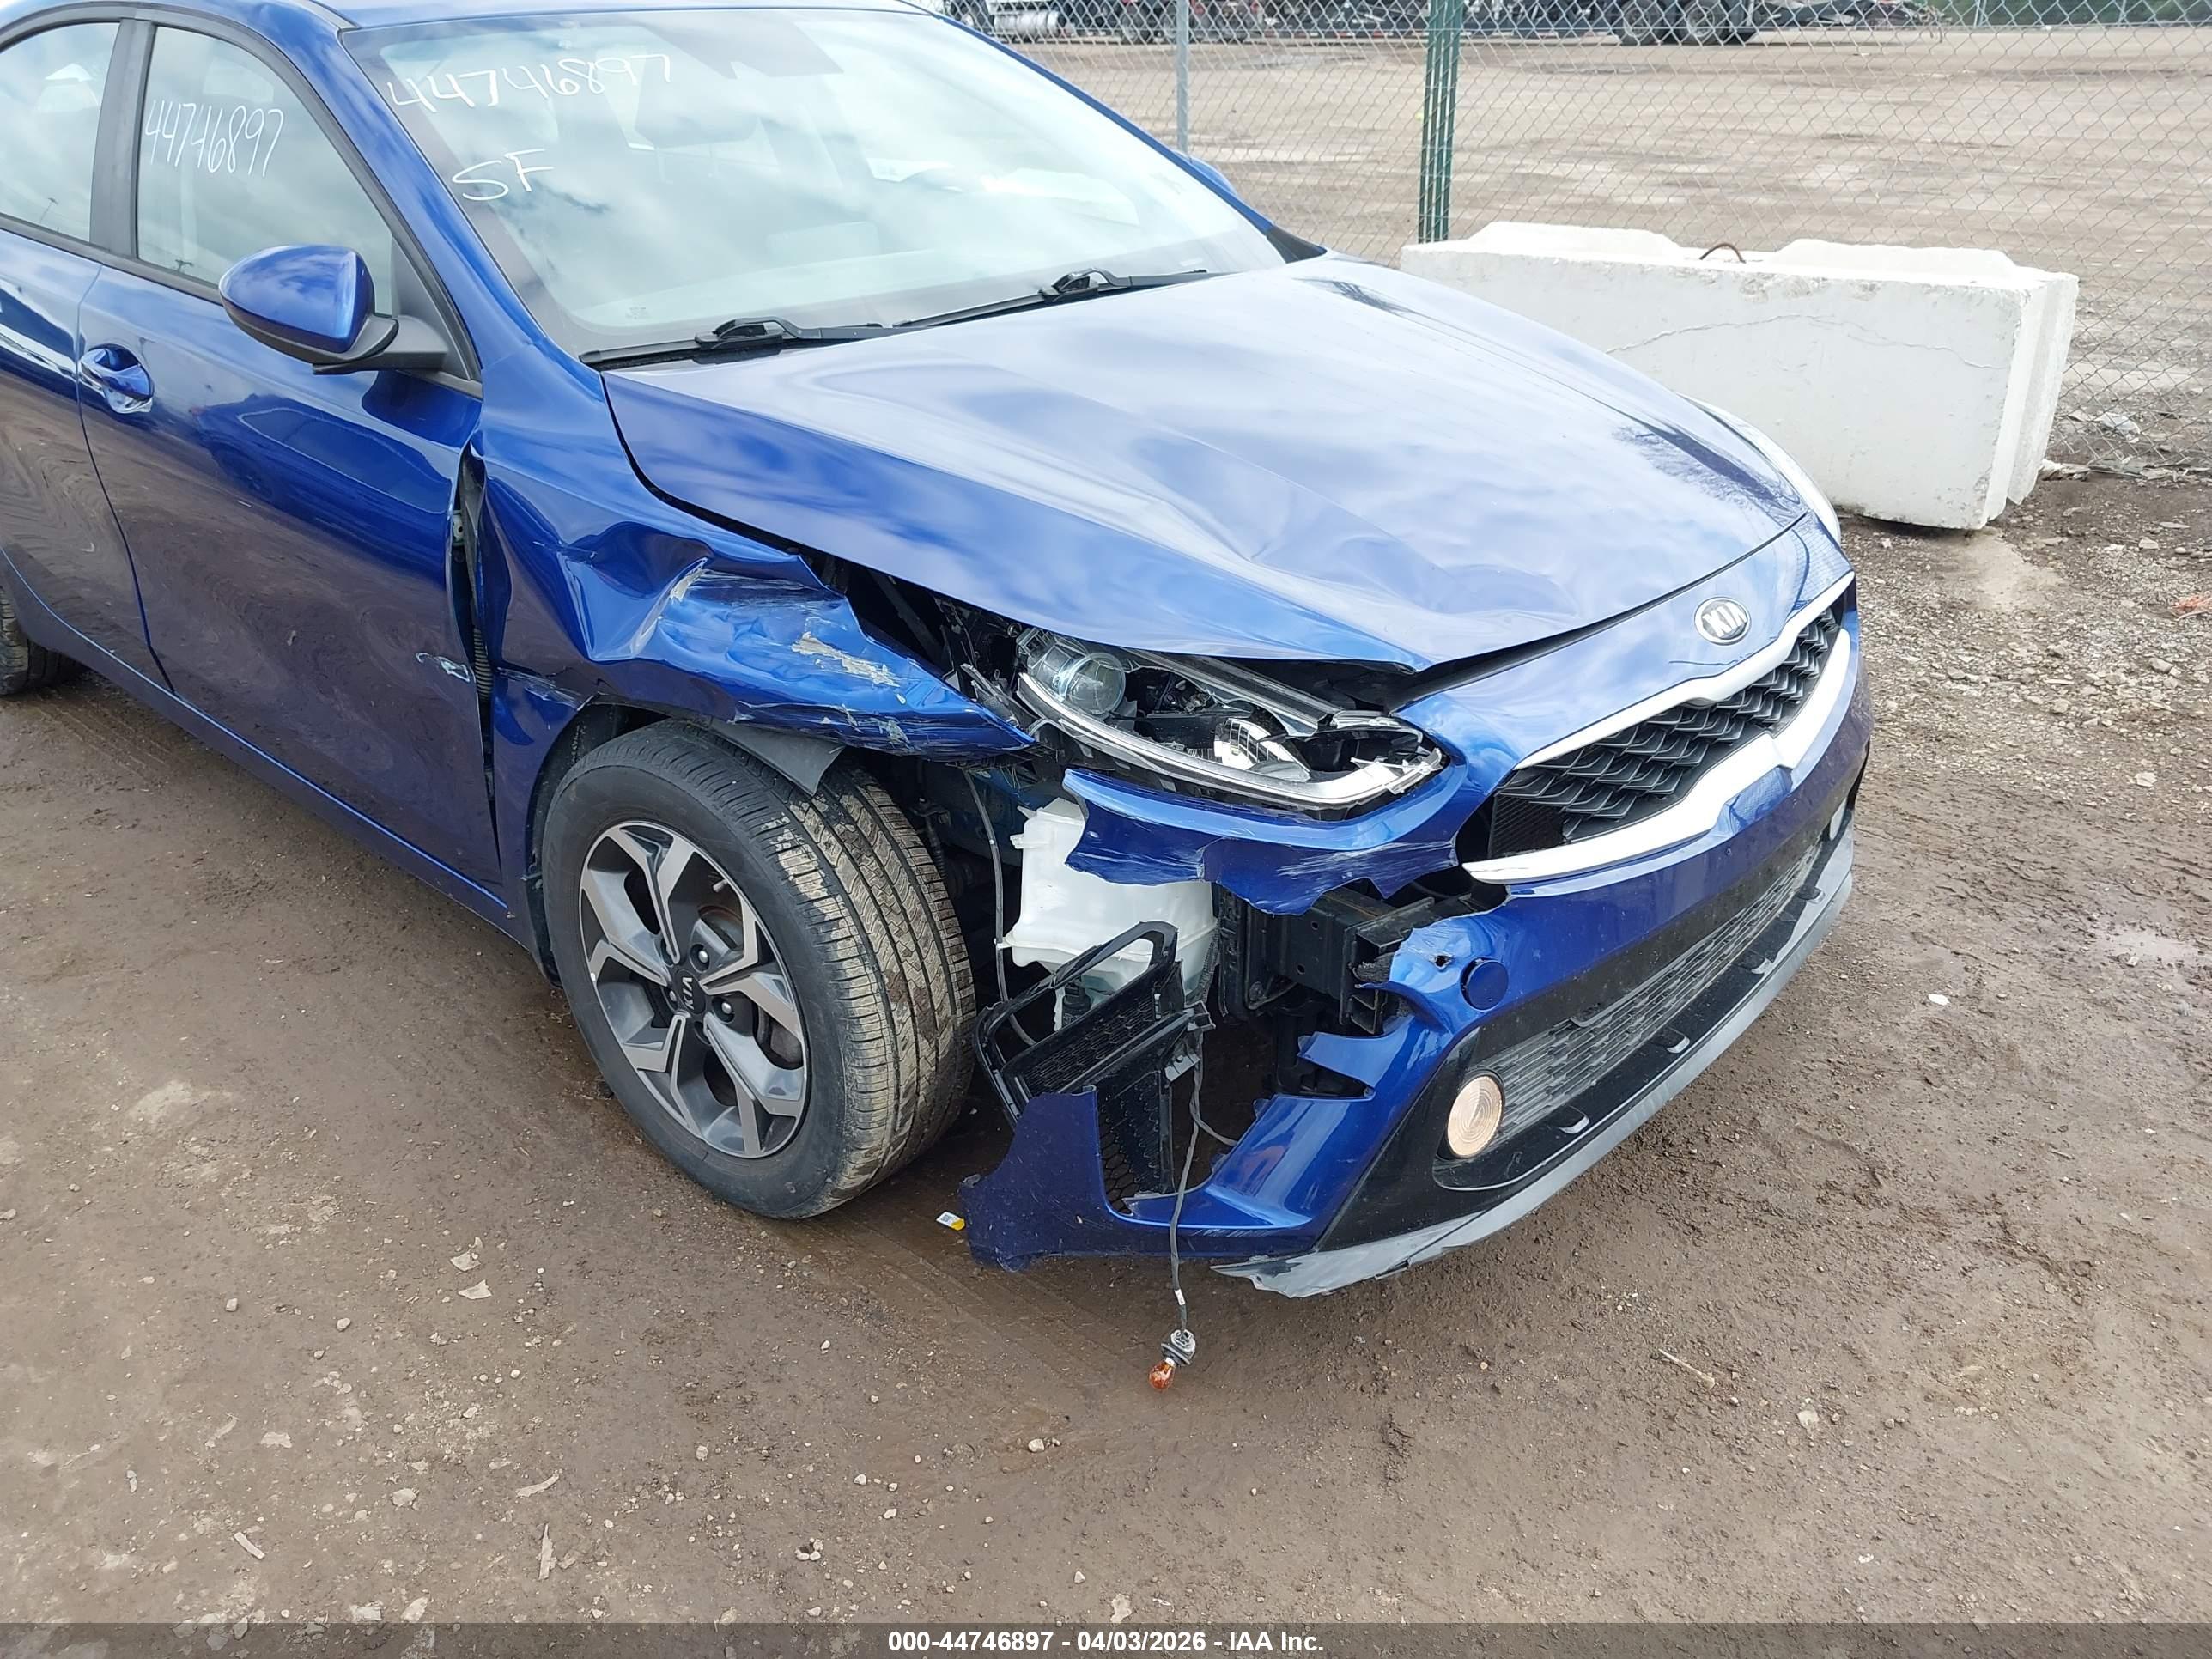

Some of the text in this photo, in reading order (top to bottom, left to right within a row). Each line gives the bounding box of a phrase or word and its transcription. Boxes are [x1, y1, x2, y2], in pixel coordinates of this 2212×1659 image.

[387, 53, 672, 113] 44746897
[144, 99, 284, 177] 44746897
[452, 148, 554, 201] SF
[1702, 602, 1747, 638] KIA
[682, 976, 695, 1011] KIA
